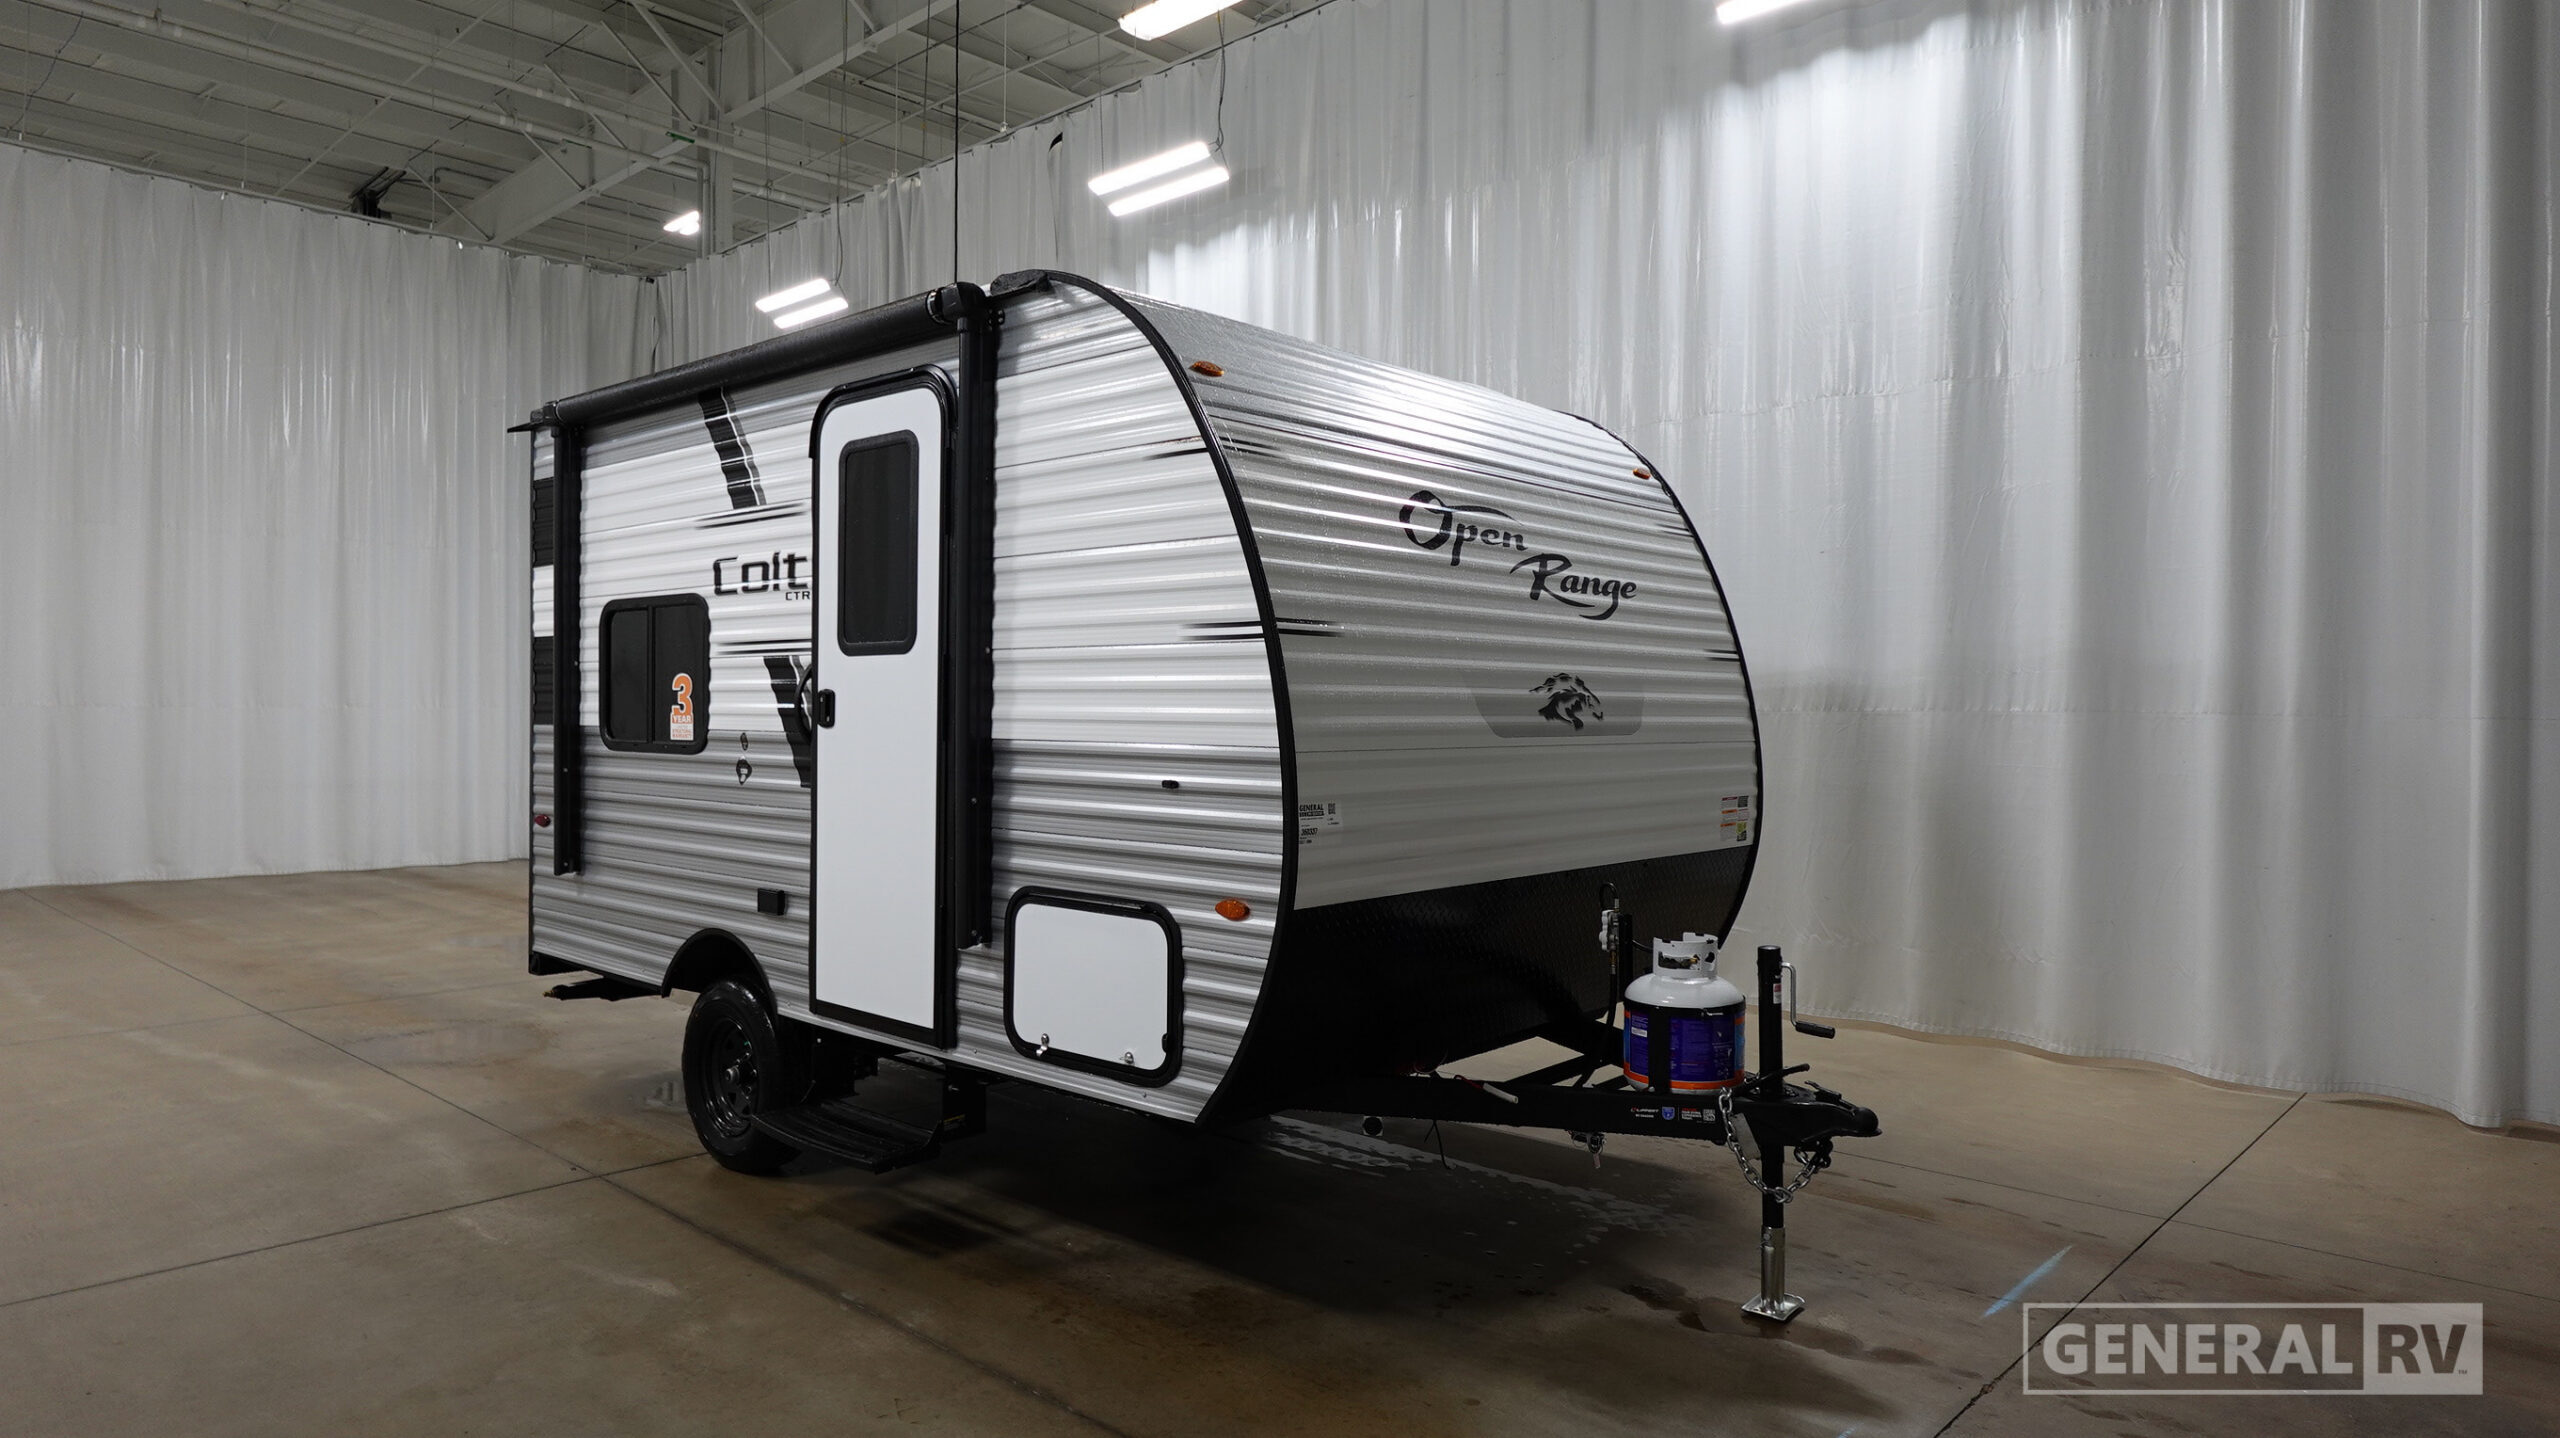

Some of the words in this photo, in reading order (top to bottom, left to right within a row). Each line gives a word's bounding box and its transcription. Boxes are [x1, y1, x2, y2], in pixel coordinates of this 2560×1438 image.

[1399, 490, 1528, 566] Open
[713, 551, 808, 595] Colt
[1510, 553, 1637, 620] Range
[785, 591, 811, 601] CTR
[672, 673, 693, 716] 3
[672, 715, 692, 723] YEAR
